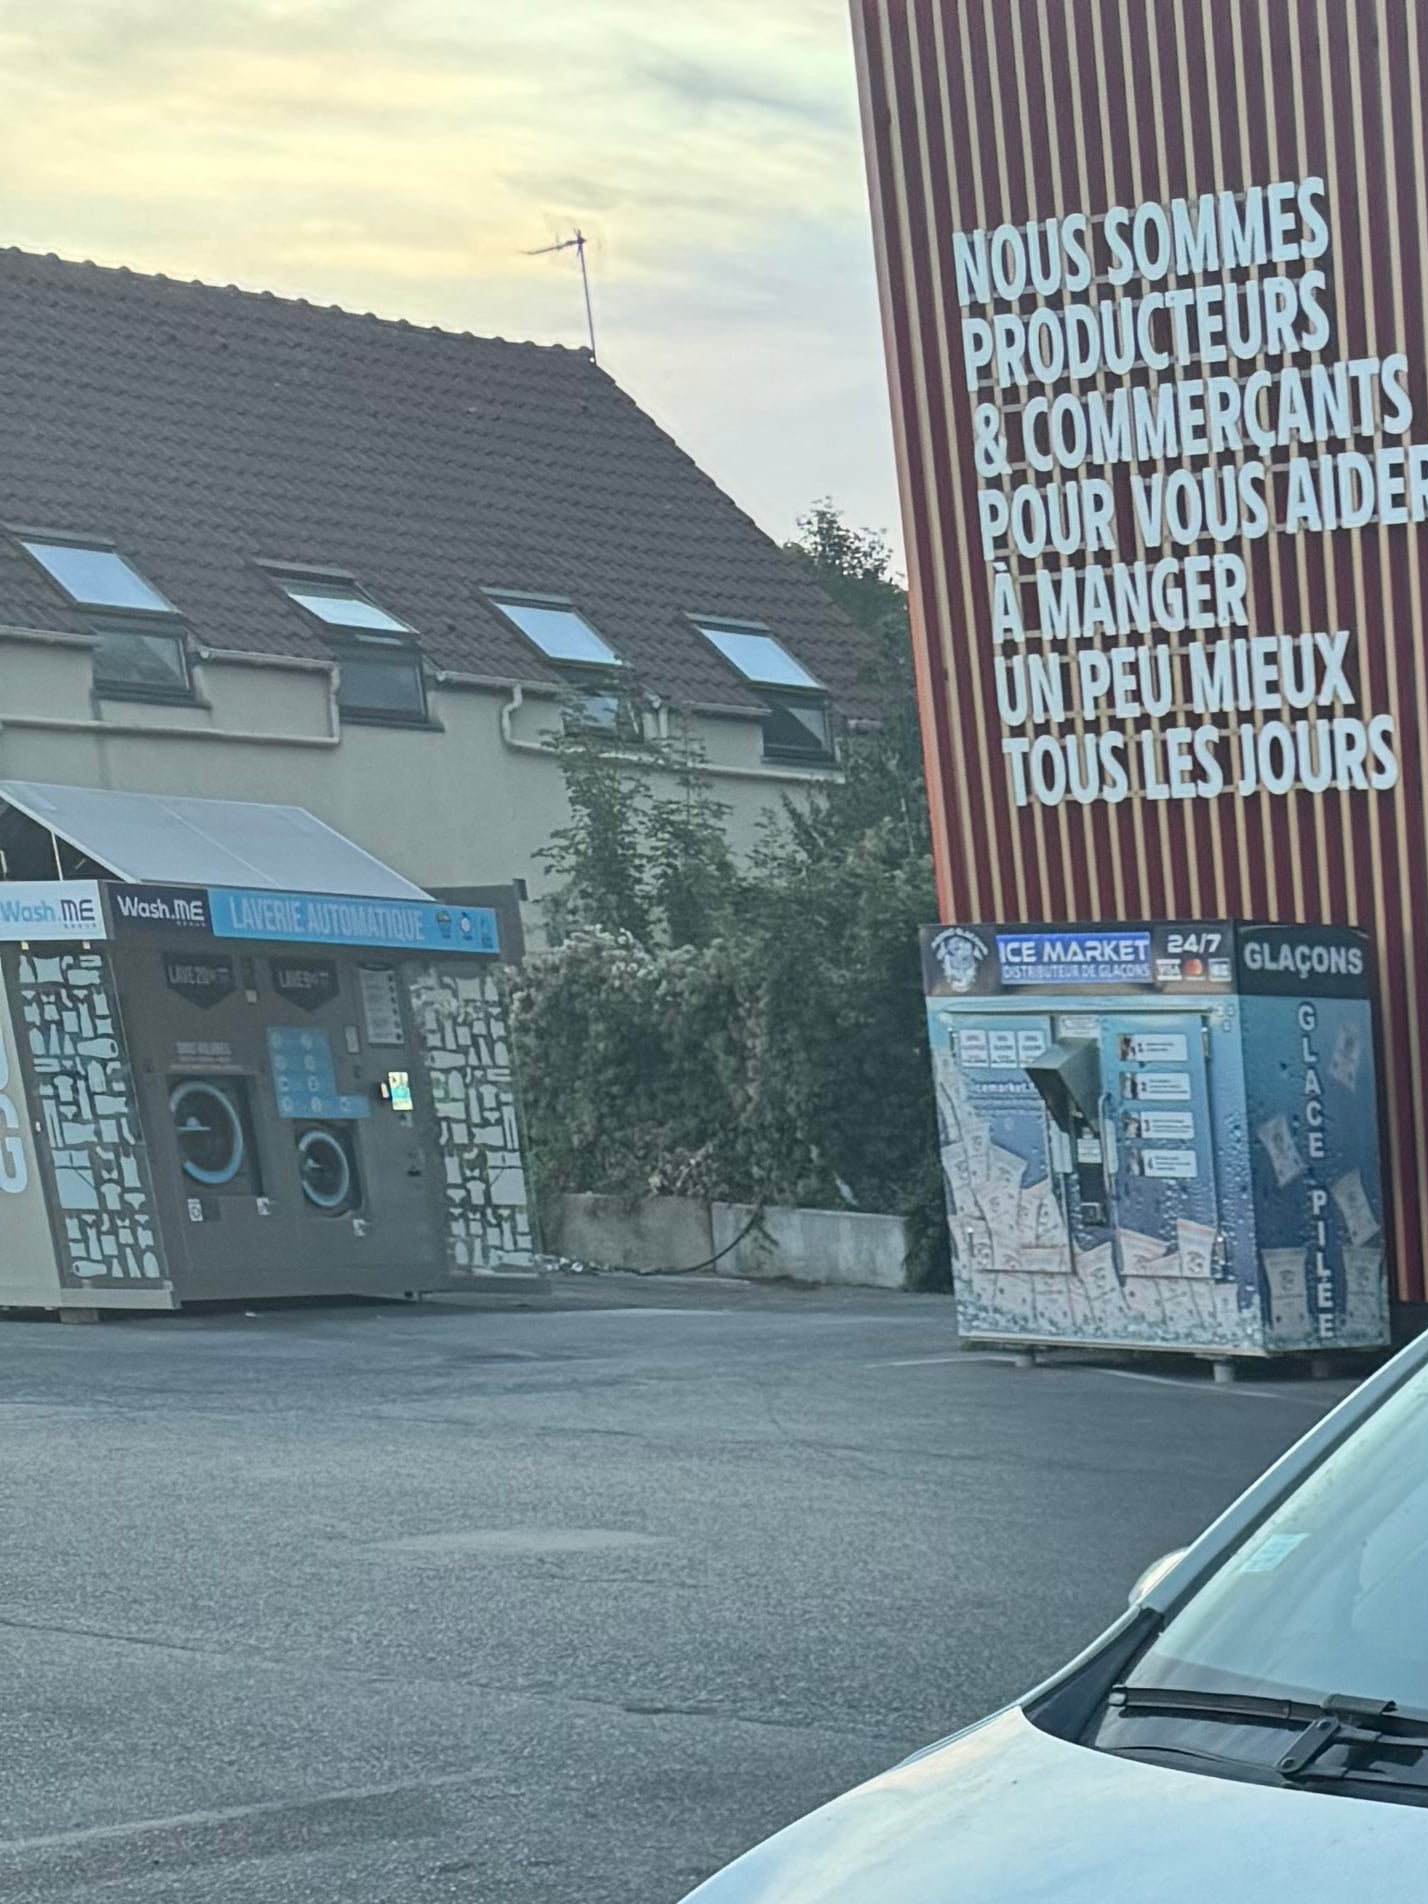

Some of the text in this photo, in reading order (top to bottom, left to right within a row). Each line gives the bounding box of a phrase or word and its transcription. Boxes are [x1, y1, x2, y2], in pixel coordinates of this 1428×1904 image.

[953, 177, 1329, 307] NOUS SOMMES
[962, 271, 1330, 391] PRODUCTEURS
[974, 352, 1413, 478] & COMMERÇANTS
[977, 478, 1116, 561] POUR
[1131, 461, 1269, 548] VOUS
[993, 552, 1249, 643] À MANGER
[994, 630, 1356, 727] UN PEU MIEUX
[1001, 714, 1399, 807] TOUS LES JOURS
[229, 897, 425, 941] LAVERIE AUTOMATIQUE
[1000, 941, 1036, 963] ICE
[1043, 938, 1150, 962] MARKET
[1167, 933, 1221, 954] 24/7
[1244, 942, 1363, 979] GLAÇONS
[1003, 964, 1079, 979] DISTRIBUTEUR
[1080, 964, 1097, 978] DE
[1298, 1004, 1325, 1158] GLACE
